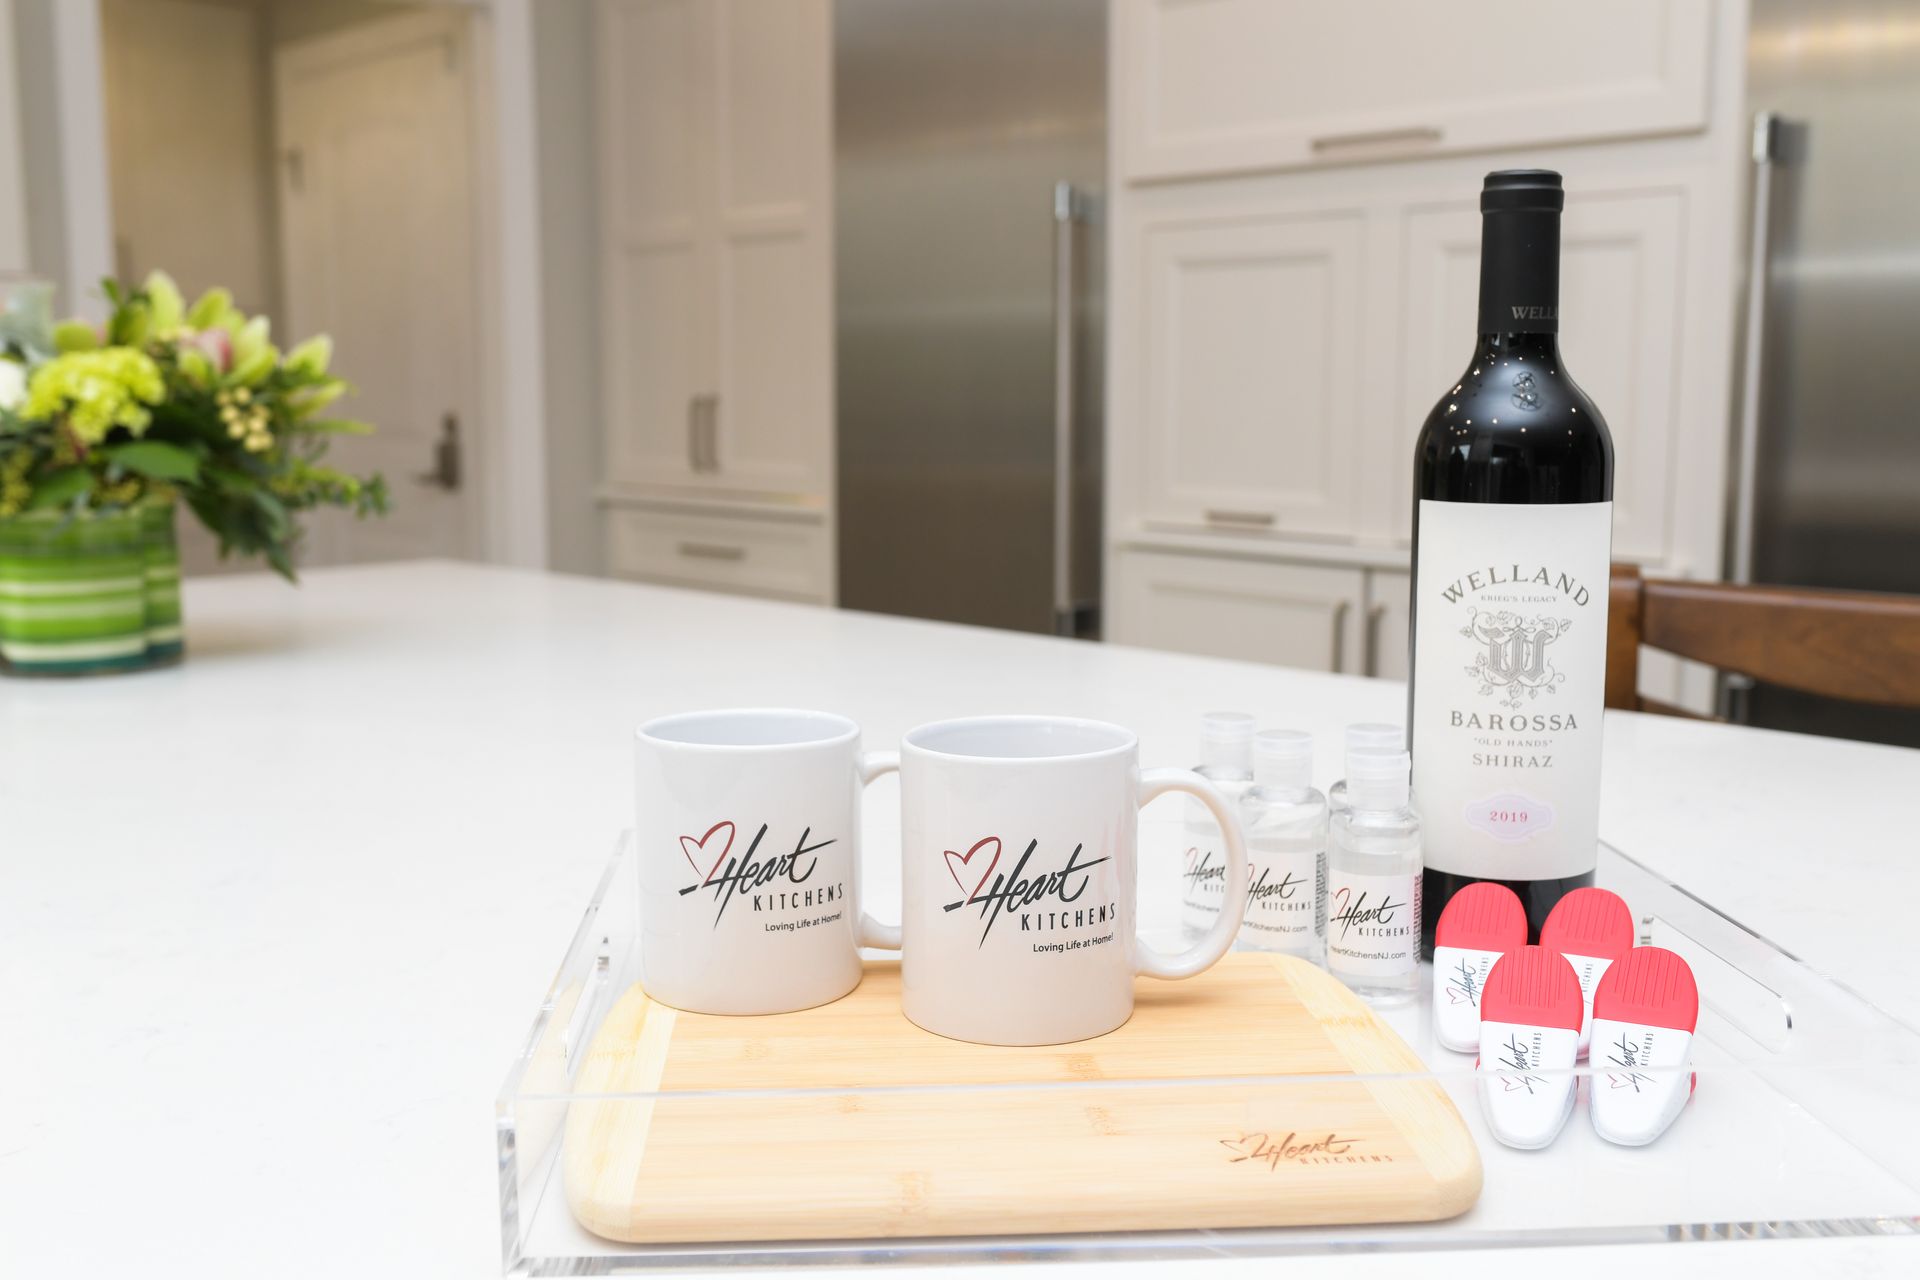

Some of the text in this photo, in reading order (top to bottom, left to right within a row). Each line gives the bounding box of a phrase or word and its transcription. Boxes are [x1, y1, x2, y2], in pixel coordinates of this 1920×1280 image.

[1441, 564, 1589, 607] WELLAND
[1522, 595, 1557, 603] LEGACY
[1450, 711, 1578, 732] BAROSSA
[1473, 753, 1553, 768] SHIRAZ
[1490, 811, 1528, 823] 2019
[700, 823, 838, 931] Heart
[753, 882, 843, 911] KITCHENS
[965, 838, 1112, 950] Heart
[1262, 901, 1311, 911] KITCHENS
[1336, 892, 1407, 941] Heart
[765, 911, 842, 932] Loving Life at Home!
[1021, 903, 1115, 931] KITCHENS
[1033, 932, 1114, 953] Loving Life at Home!
[1359, 927, 1410, 937] KITCHENS
[1251, 1132, 1367, 1172] Heart
[1299, 1155, 1394, 1165] KITCHENS
